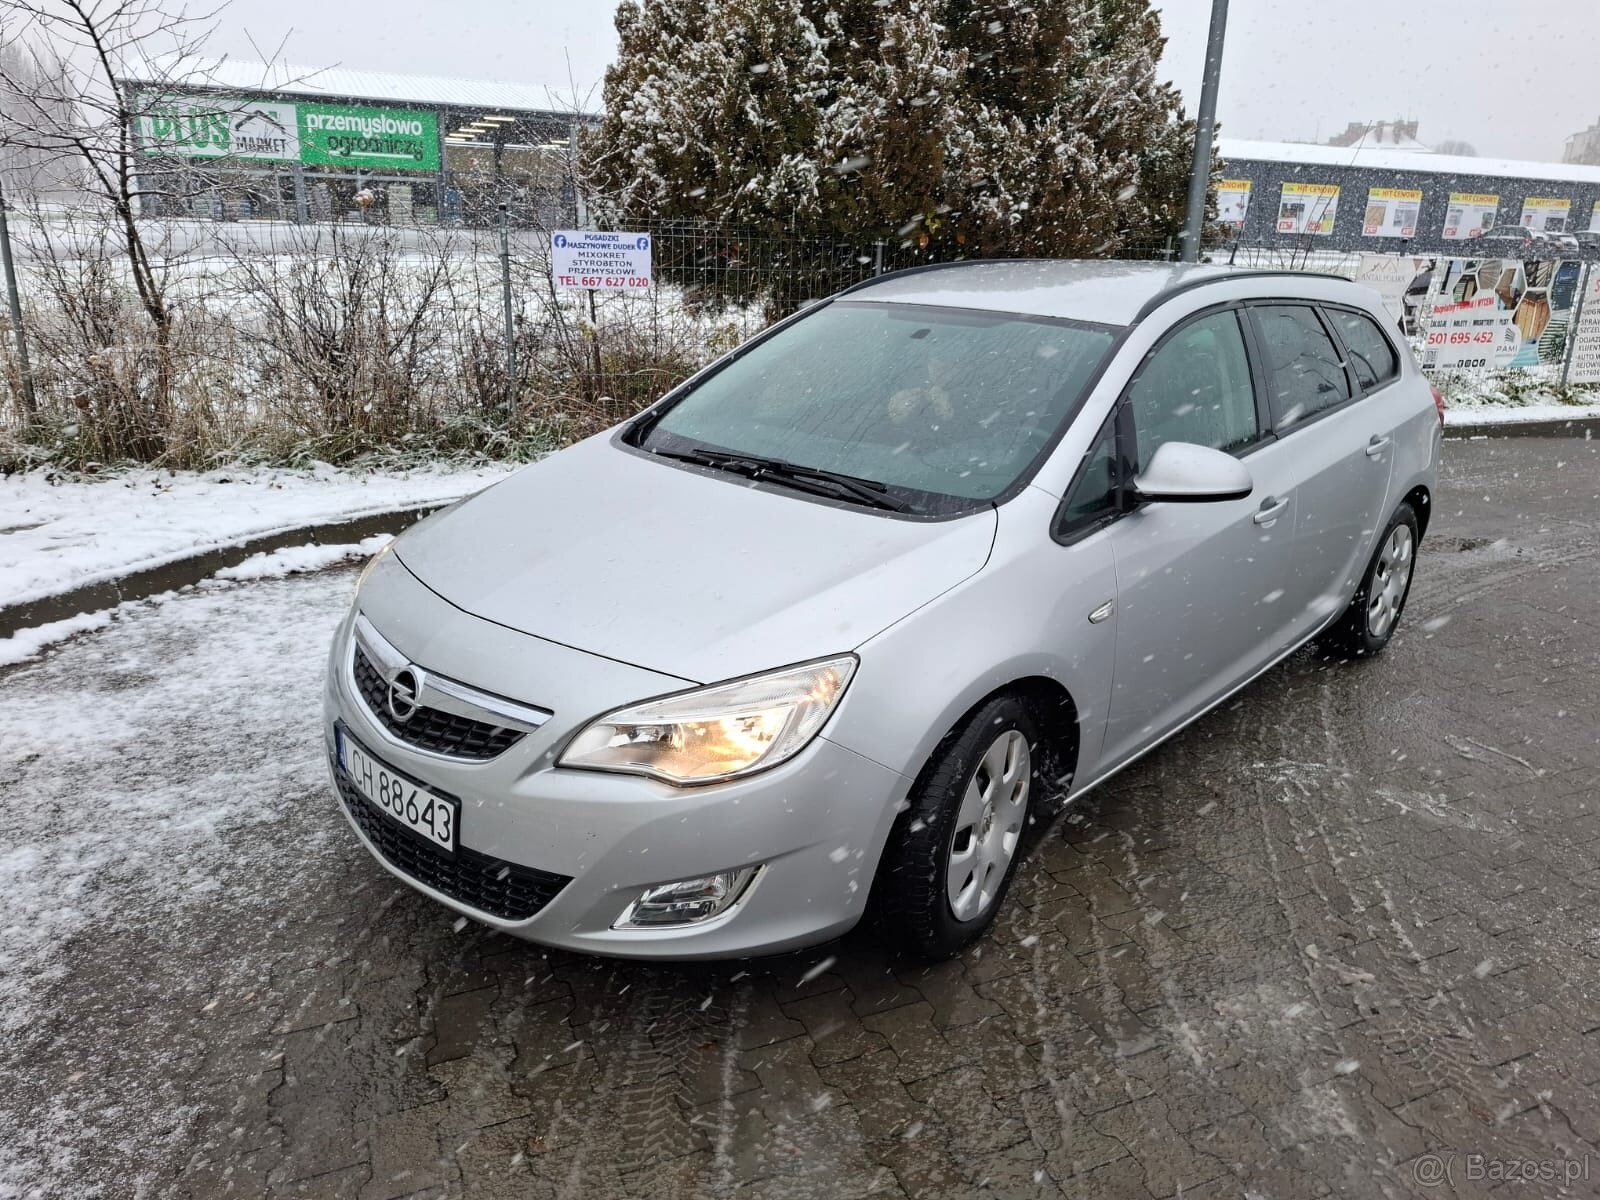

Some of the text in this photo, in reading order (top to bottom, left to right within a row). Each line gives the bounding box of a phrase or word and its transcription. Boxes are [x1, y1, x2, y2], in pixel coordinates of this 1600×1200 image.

[235, 137, 286, 153] MARKET
[327, 135, 424, 161] ogrodniczy
[567, 242, 611, 250] MASZYNOWE
[558, 276, 648, 288] TEL 667 627 020
[1428, 331, 1494, 344] 501 695 452
[379, 770, 452, 843] 88643
